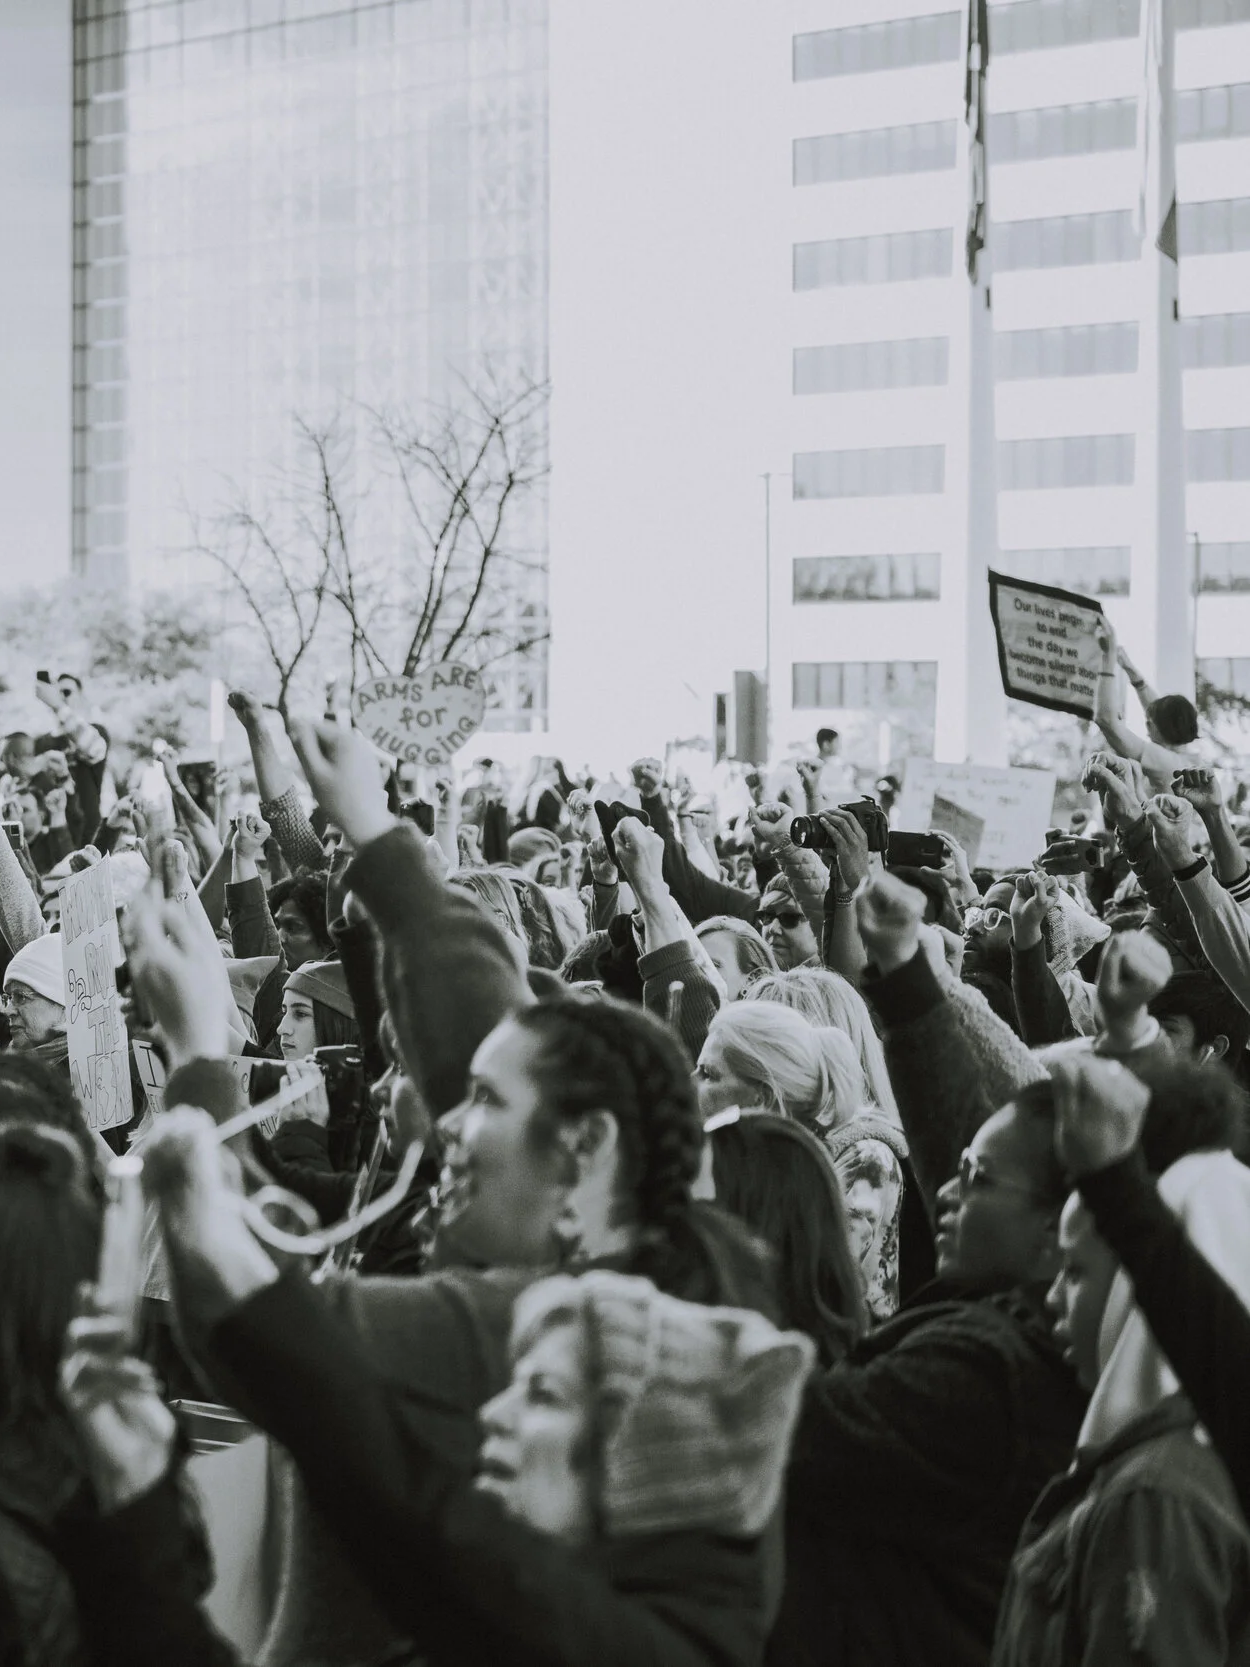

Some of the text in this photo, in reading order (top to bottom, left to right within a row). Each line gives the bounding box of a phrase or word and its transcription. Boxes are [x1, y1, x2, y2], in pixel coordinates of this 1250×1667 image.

[1014, 597, 1032, 613] Our
[1034, 603, 1055, 619] lives
[1036, 621, 1067, 639] to end
[1027, 636, 1079, 659] the day we
[1048, 658, 1077, 676] silent
[358, 666, 478, 713] ARMS ARE
[1016, 666, 1094, 697] things that matte
